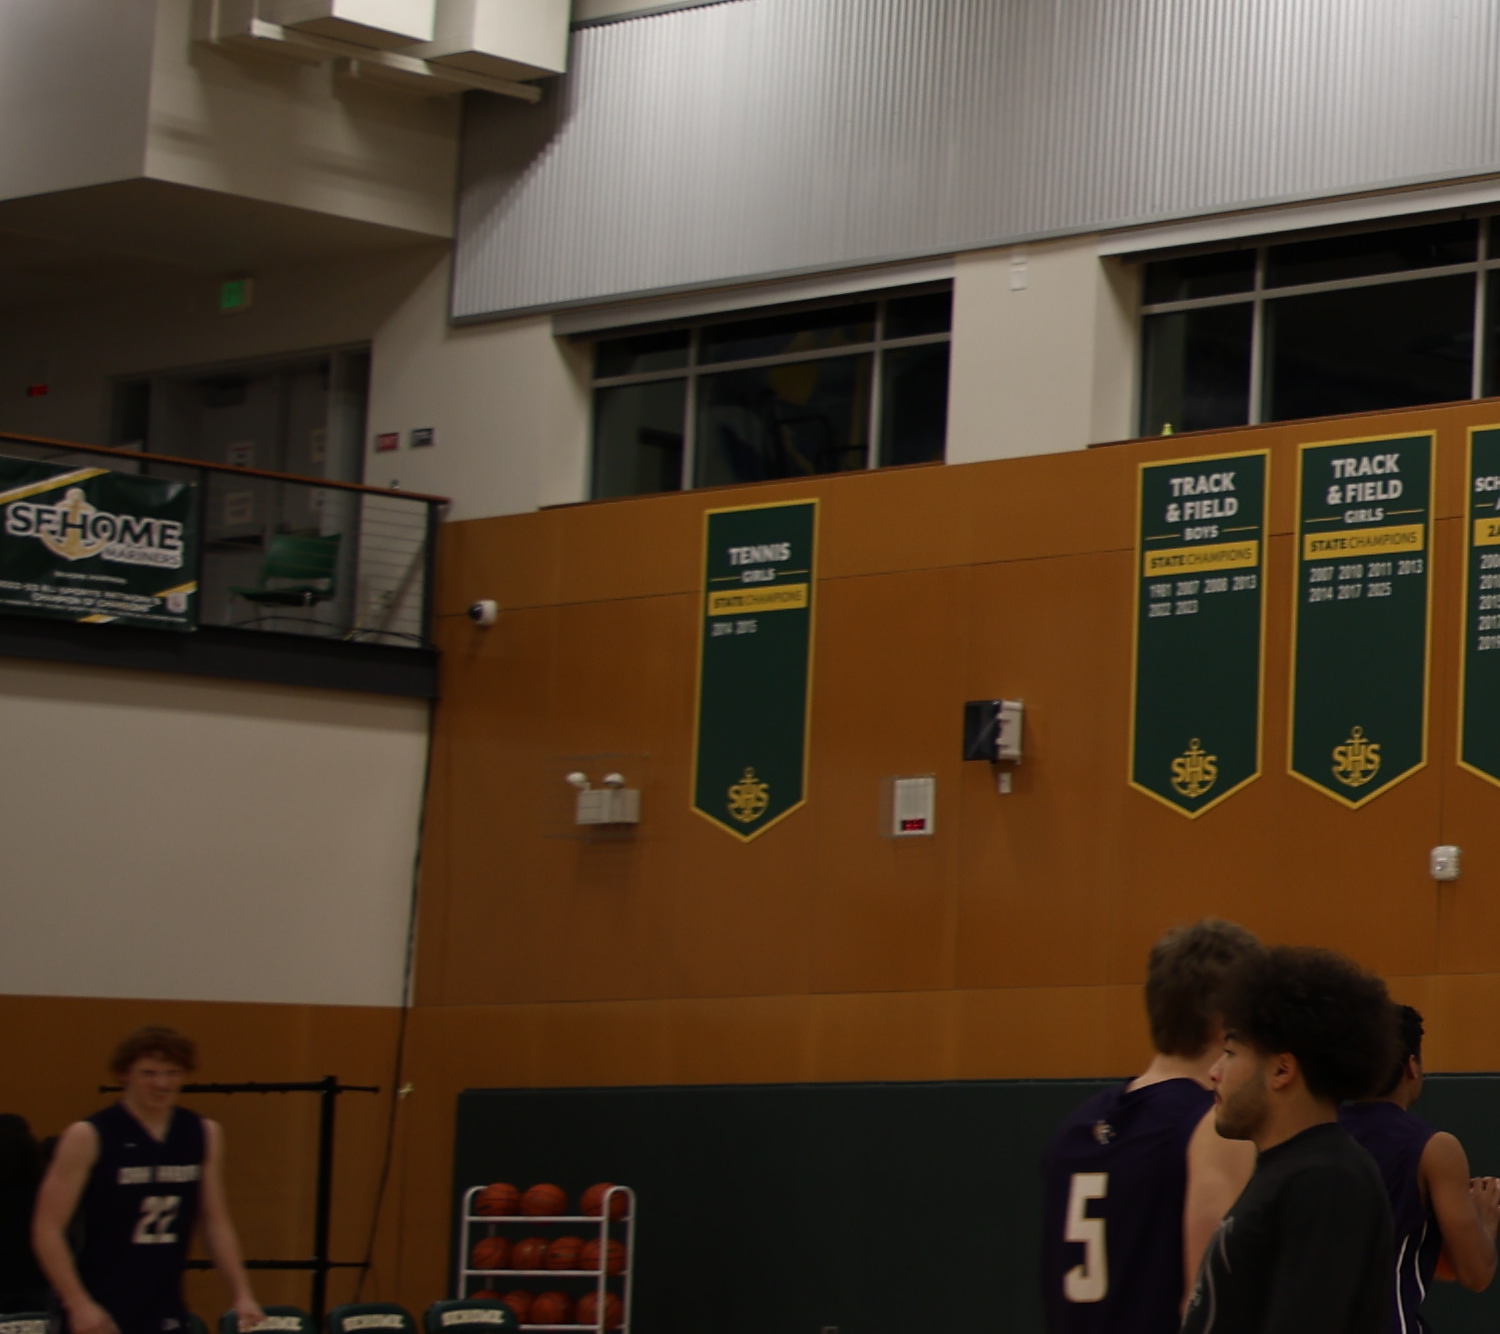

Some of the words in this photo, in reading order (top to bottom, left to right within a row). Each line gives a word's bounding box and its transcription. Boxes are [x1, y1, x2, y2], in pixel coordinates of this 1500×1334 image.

[1331, 453, 1400, 479] TRACK
[1168, 472, 1236, 497] TRACK
[1326, 485, 1342, 505] &
[1345, 479, 1404, 503] FIELD
[1165, 503, 1181, 523] &
[1183, 497, 1239, 521] FIELD
[1344, 508, 1384, 523] GIRLS
[8, 503, 181, 551] SEHOME
[1184, 525, 1219, 541] BOYS
[728, 542, 792, 565] TENNIS
[1311, 538, 1347, 552] STATE
[1349, 531, 1417, 549] CHAMPIONS
[1150, 554, 1185, 569] STATE
[1187, 548, 1253, 566] CHAMPIONS
[741, 569, 776, 583] GIRLS
[1169, 754, 1219, 783] SHS
[1331, 742, 1382, 773] SHS
[131, 1195, 183, 1245] 22
[1062, 1171, 1110, 1304] 5
